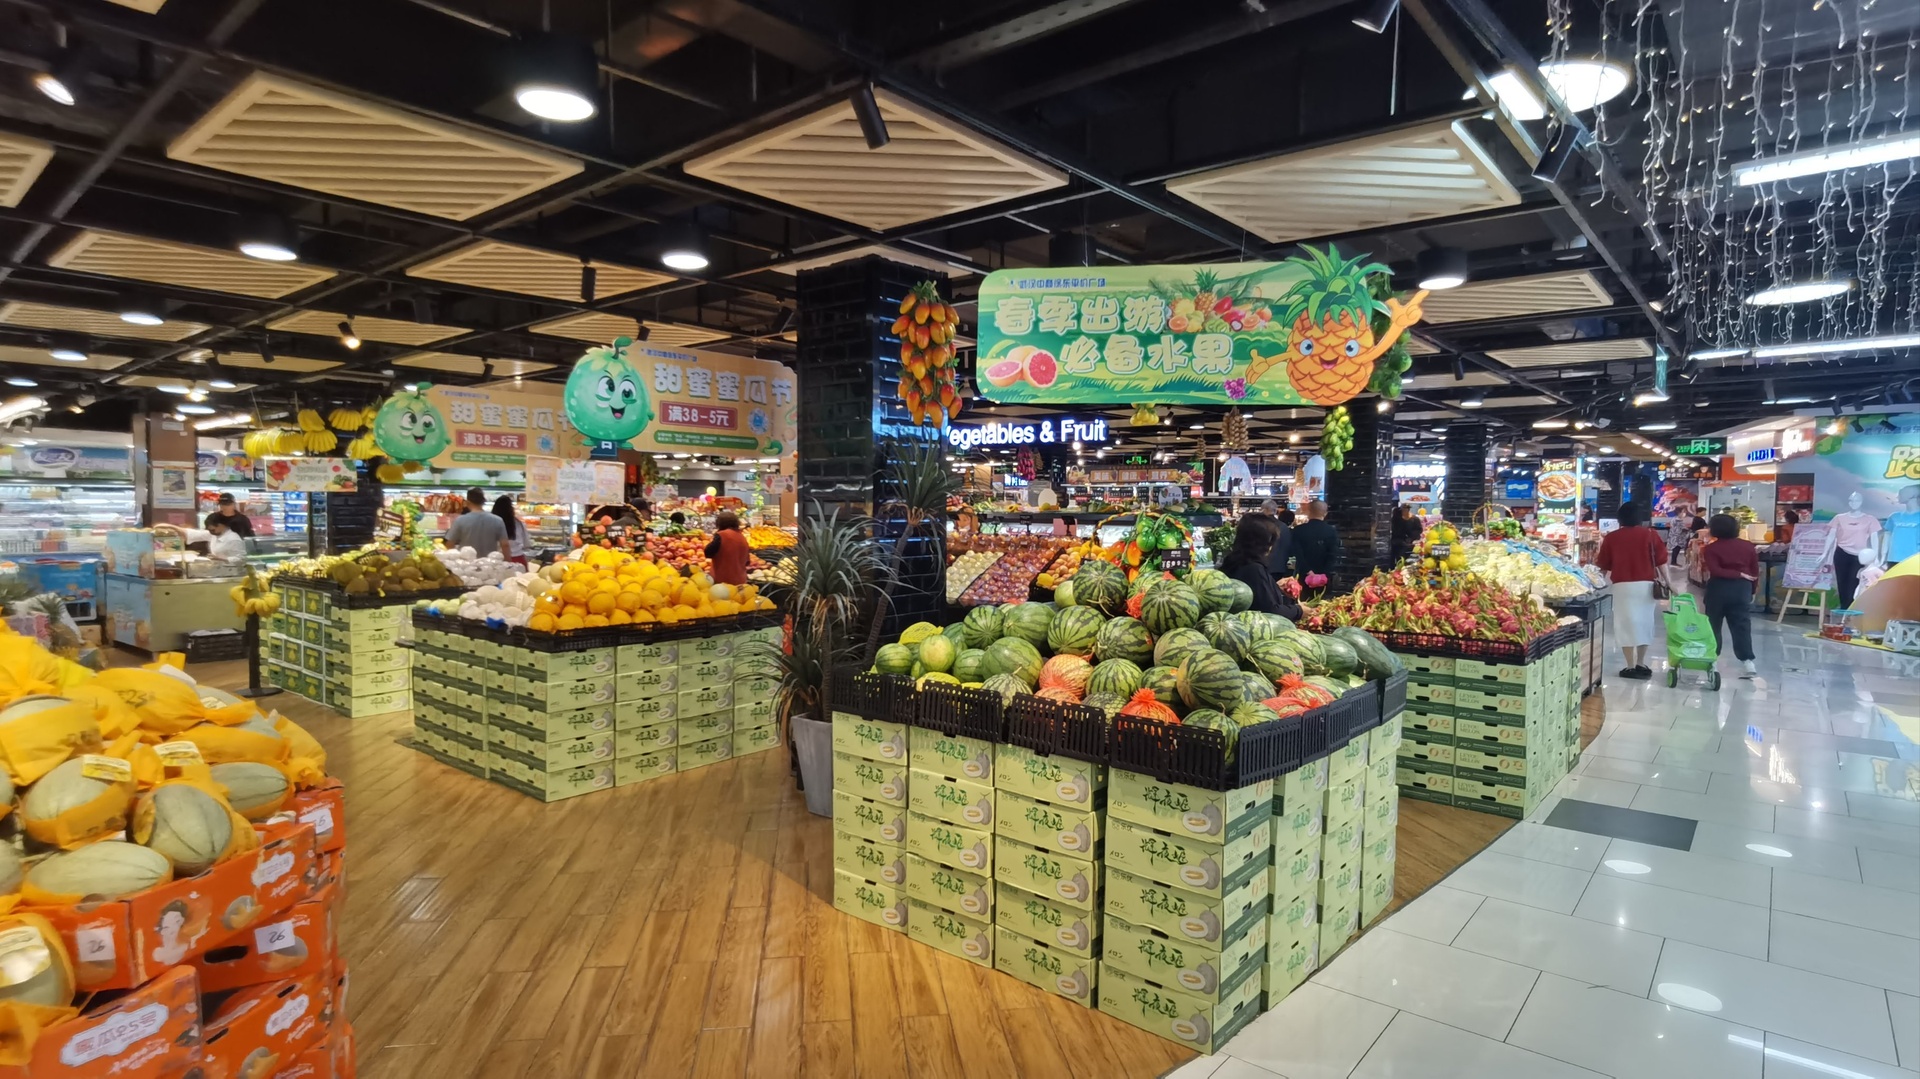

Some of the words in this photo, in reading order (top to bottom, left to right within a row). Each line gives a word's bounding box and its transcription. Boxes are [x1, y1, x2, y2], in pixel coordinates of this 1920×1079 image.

[994, 295, 1168, 335] 春季出游
[1060, 334, 1234, 375] 必备水果
[654, 362, 793, 407] 甜蜜蜜瓜节
[1039, 421, 1055, 443] &
[1060, 419, 1106, 442] Fruit
[1112, 800, 1127, 809] メロン
[1110, 850, 1125, 859] メロン
[1109, 900, 1125, 909] メロン
[268, 929, 286, 944] 26
[89, 939, 105, 953] 26
[1108, 950, 1122, 959] メロン
[1103, 998, 1117, 1006] メロン
